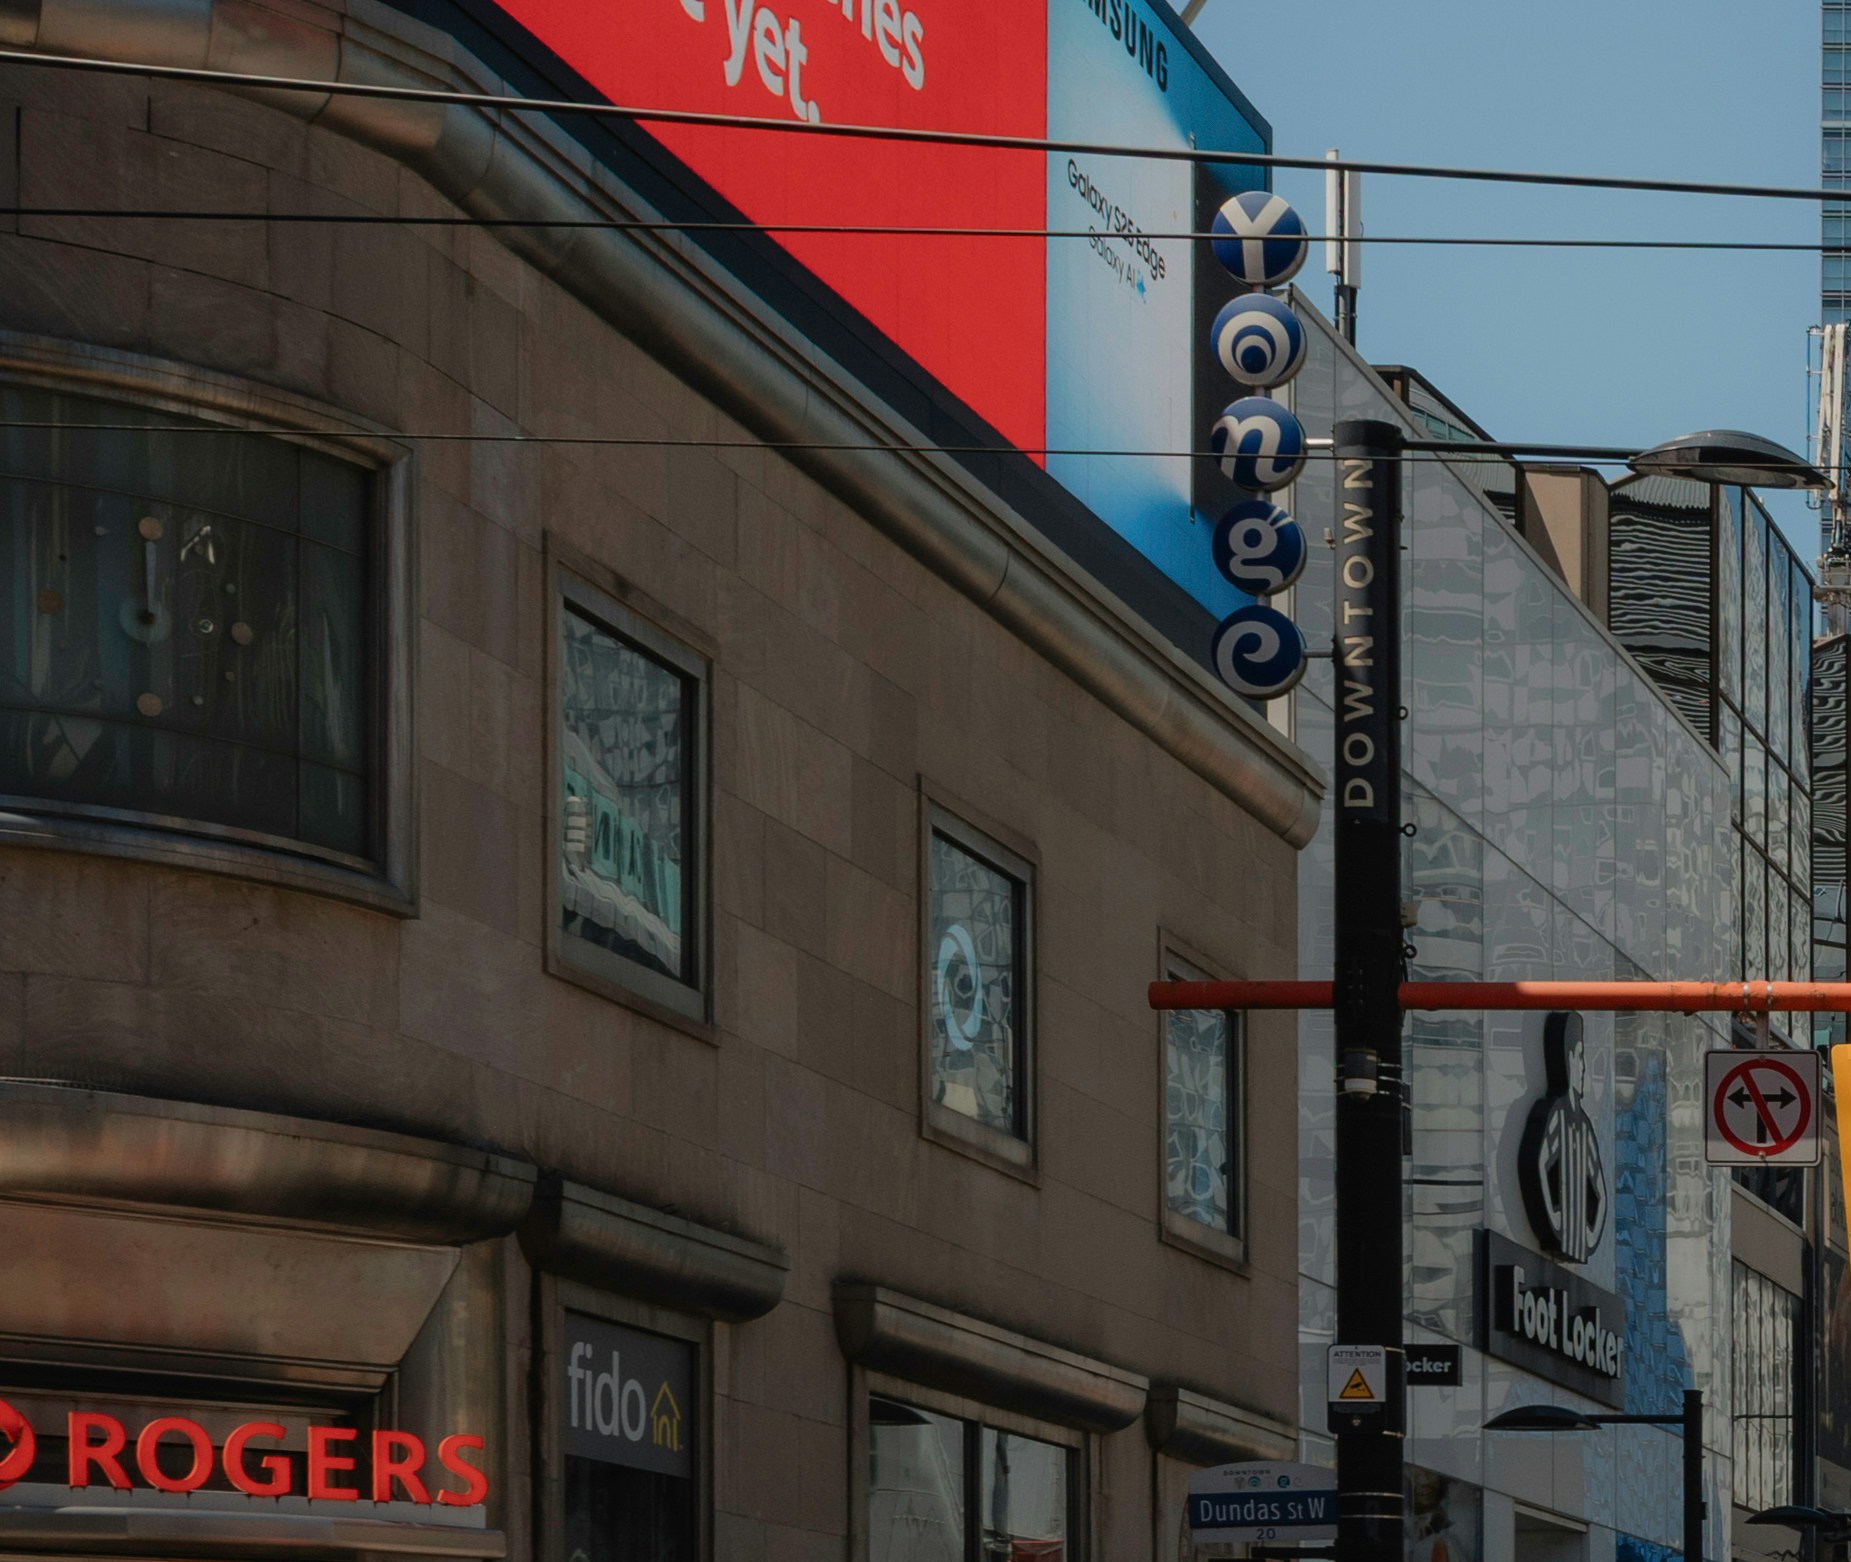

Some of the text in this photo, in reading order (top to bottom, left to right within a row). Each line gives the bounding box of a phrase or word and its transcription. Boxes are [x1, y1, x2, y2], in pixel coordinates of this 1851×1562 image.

[724, 0, 820, 124] yet.
[1067, 158, 1166, 281] Galaxy S25 Edge
[1088, 225, 1124, 283] Galaxy
[1212, 192, 1296, 699] Yonge
[1344, 457, 1375, 809] DOWNTOWN
[1333, 1350, 1382, 1358] ATTENTION
[1406, 1356, 1452, 1373] ocker
[1514, 1265, 1624, 1379] Foot Locker
[567, 1341, 646, 1442] fido
[67, 1411, 489, 1508] ROGERS
[1201, 1497, 1325, 1522] Dundas St W
[1257, 1528, 1276, 1540] 20
